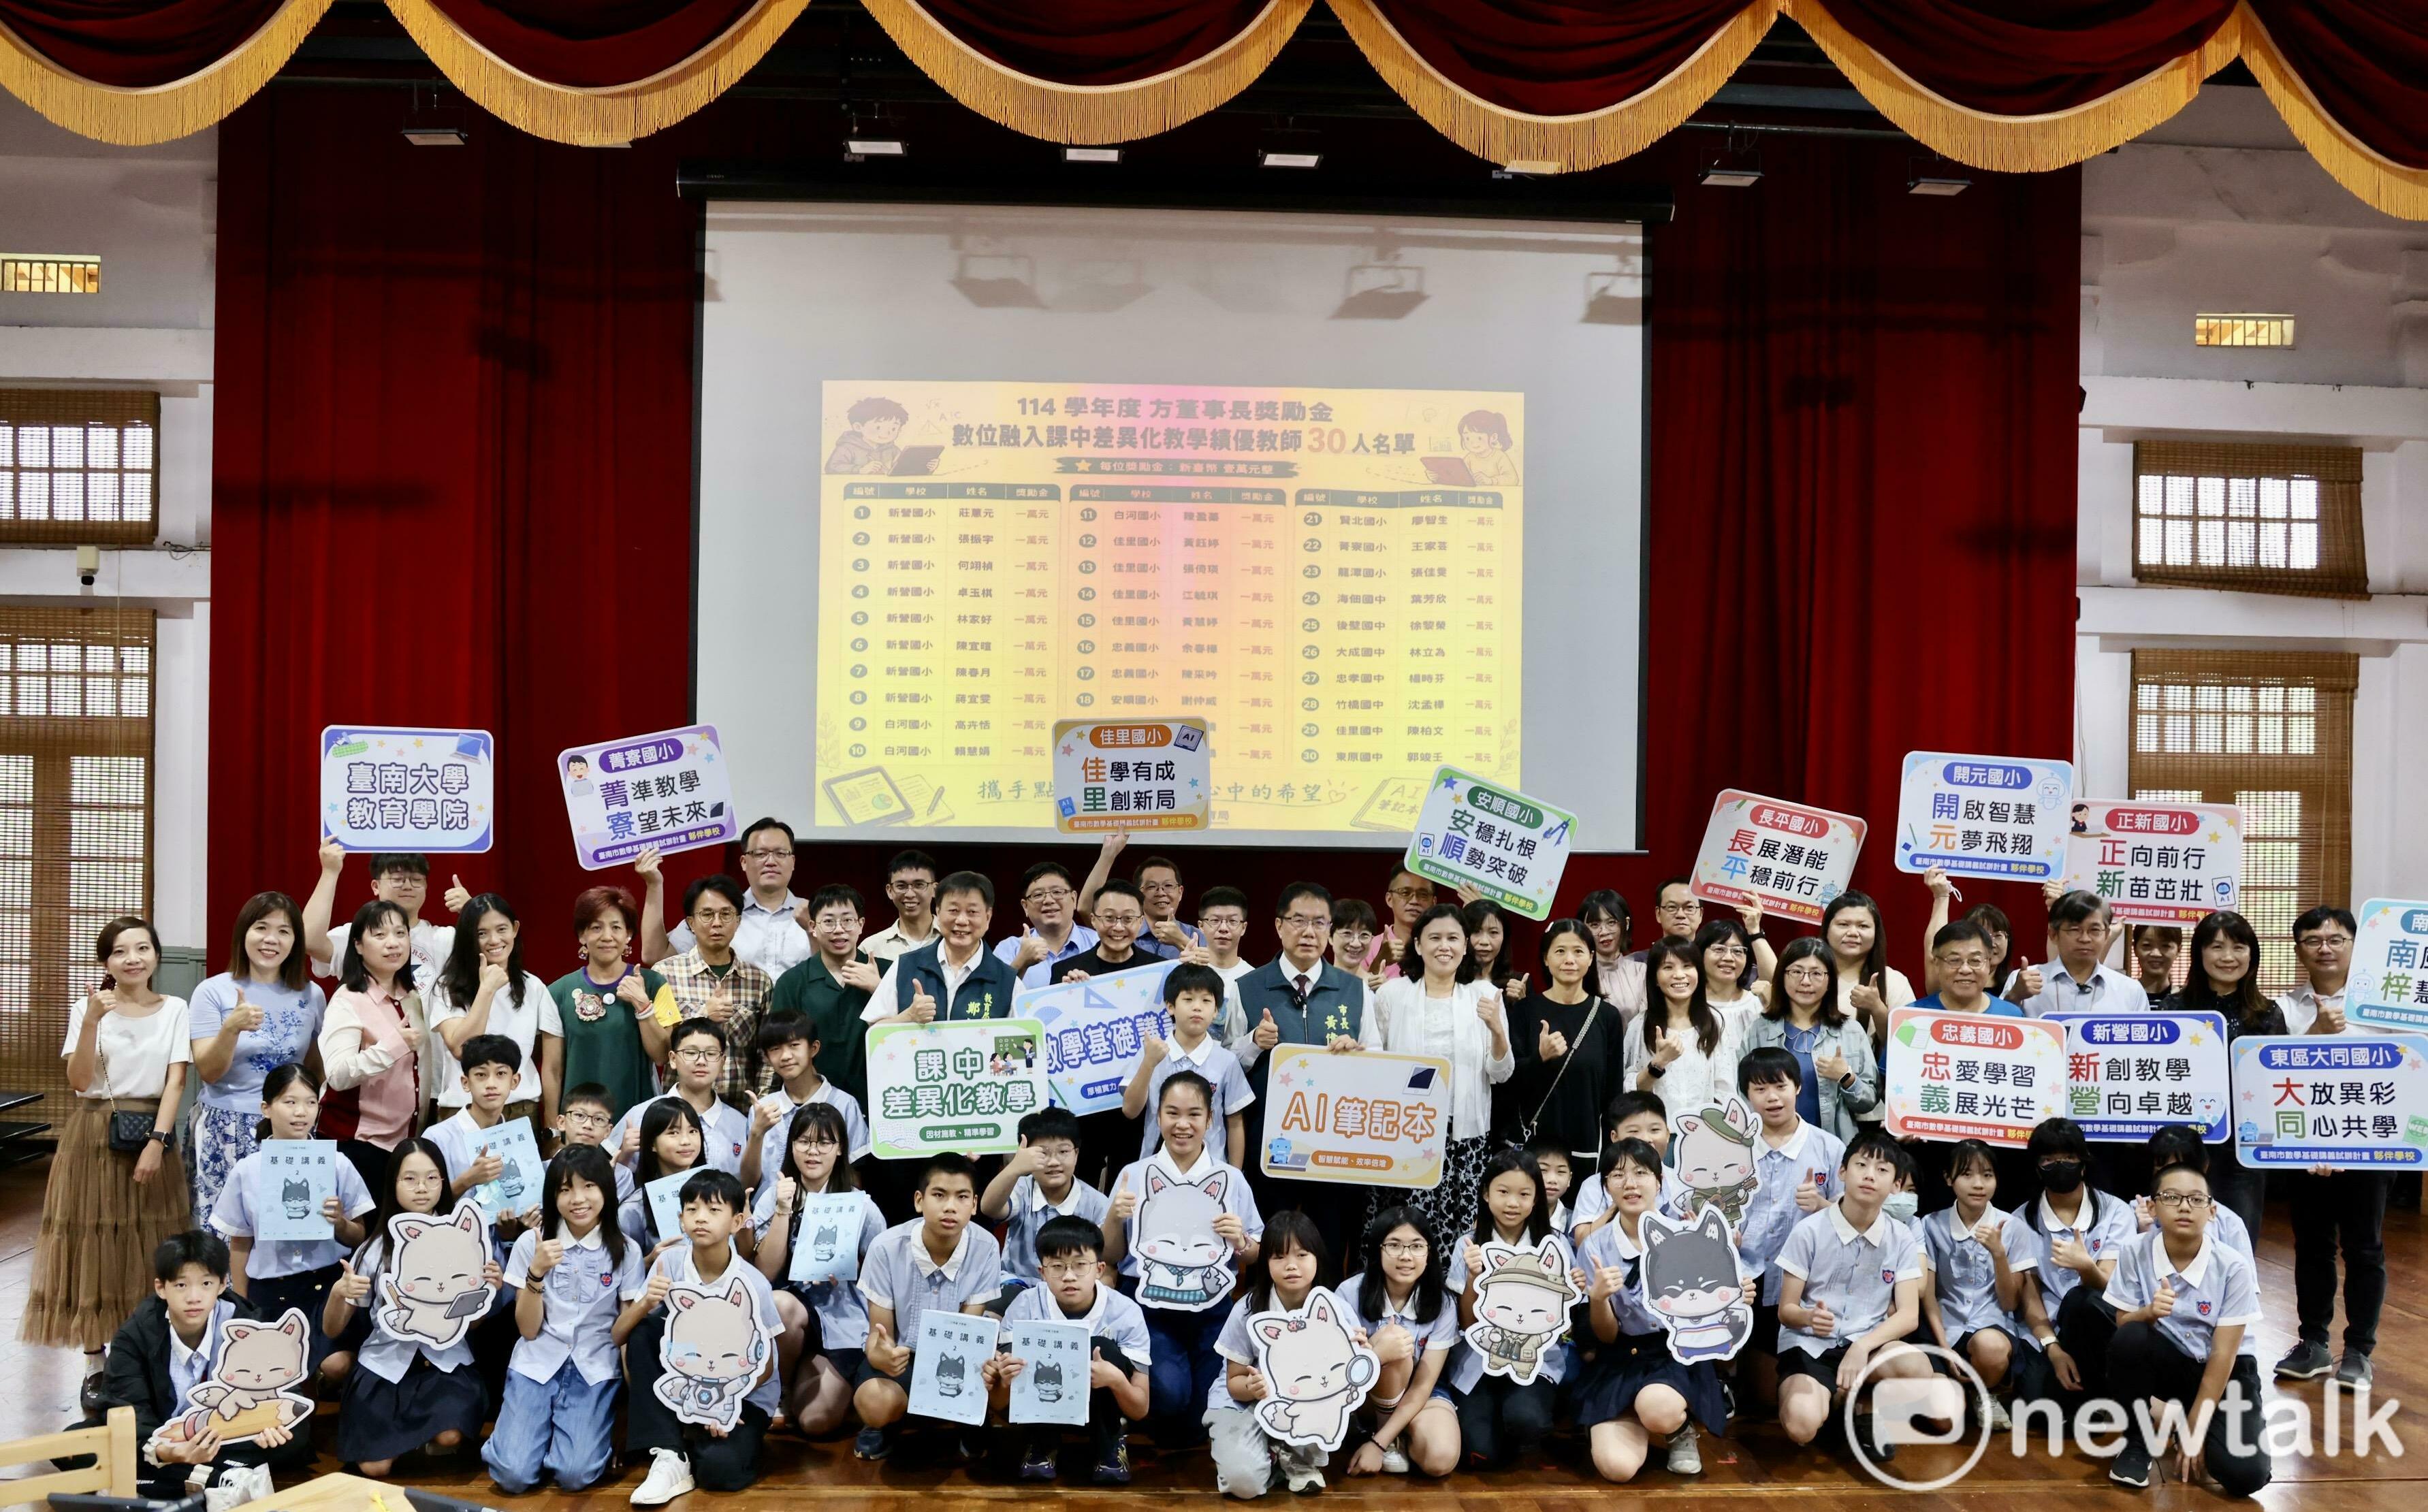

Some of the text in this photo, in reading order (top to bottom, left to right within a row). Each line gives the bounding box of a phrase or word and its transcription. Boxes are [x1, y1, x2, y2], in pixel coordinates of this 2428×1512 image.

[1017, 397, 1333, 422] 114 學年度 方董事長獎勵金
[953, 423, 1416, 454] 數位融入課中差異化教學績優教師 30 人名單
[905, 487, 927, 496] 學校
[966, 487, 987, 496] 姓名
[1420, 495, 1442, 503] 姓名
[1115, 511, 1160, 520] 白河國小
[1241, 513, 1274, 523] 一萬元
[1468, 517, 1494, 526] 一萬元
[889, 534, 935, 543] 新營國小
[1016, 536, 1049, 545] 一萬元
[886, 641, 933, 649] 新營國小
[1014, 641, 1047, 650] 一萬元
[1337, 647, 1384, 657] 大成國中
[1410, 648, 1445, 657] 林立為
[1467, 647, 1492, 656] 一萬元
[886, 666, 932, 676] 新營國小
[956, 668, 990, 677] 陳春月
[1013, 668, 1046, 677] 一萬元
[886, 693, 931, 703] 新營國小
[1013, 694, 1046, 703] 一萬元
[1111, 695, 1158, 705] 安順國小
[1240, 698, 1273, 707] 一萬元
[1336, 700, 1383, 709] 竹橋國中
[1465, 700, 1492, 709] 一萬元
[885, 720, 931, 729] 白河國小
[1013, 720, 1045, 730] 一萬元
[1100, 728, 1162, 745] 佳里國小
[1183, 733, 1194, 741] AI
[1337, 726, 1383, 735] 佳里國中
[1407, 726, 1443, 735] 陳柏文
[1465, 726, 1492, 736] 一萬元
[609, 743, 674, 770] 菁寮國小
[885, 746, 931, 756] 白河國小
[1012, 746, 1045, 756] 一萬元
[1336, 752, 1382, 762] 東原國中
[1465, 753, 1491, 762] 一萬元
[347, 761, 469, 794] 臺南大學
[1081, 757, 1175, 783] 佳學有成
[1953, 765, 2021, 786] 開元國小
[600, 770, 701, 810] 菁準教學
[1083, 787, 1175, 811] 里創新局
[347, 798, 469, 830] 教育學院
[1475, 792, 1533, 824] 安順國小
[1932, 793, 2036, 824] 開啟智慧
[607, 800, 707, 841] 寮望未來
[1759, 808, 1819, 835] 長平國小
[2116, 812, 2187, 831] 正新國小
[1448, 809, 1537, 860] 安穩扎根
[1928, 824, 2032, 855] 元夢飛翔
[1437, 832, 1528, 886] 順勢突破
[1727, 829, 1829, 870] 長展潛能
[2098, 839, 2205, 869] 正向前行
[1721, 856, 1819, 896] 平穩前行
[2096, 869, 2203, 902] 新苗茁壯
[2179, 910, 2211, 919] 夥伴學
[1942, 1023, 2012, 1046] 忠義國小
[2092, 1023, 2168, 1042] 新營國小
[914, 1047, 983, 1082] 課中
[2068, 1052, 2191, 1082] 新創教學
[2269, 1047, 2391, 1067] 東區大同國小
[1921, 1052, 2035, 1087] 忠愛學習
[882, 1080, 1036, 1119] 差異化教學
[1920, 1084, 2035, 1119] 義展光芒
[2069, 1086, 2192, 1116] 營向卓越
[2273, 1077, 2396, 1106] 大放異彩
[1281, 1091, 1437, 1144] AI筆記本
[2275, 1111, 2398, 1139] 同心共學
[925, 1127, 995, 1139] 因材施教、精準學習
[270, 1156, 325, 1165] 基礎講義
[928, 1328, 985, 1345] 基礎講義
[1021, 1338, 1079, 1351] 基礎講義
